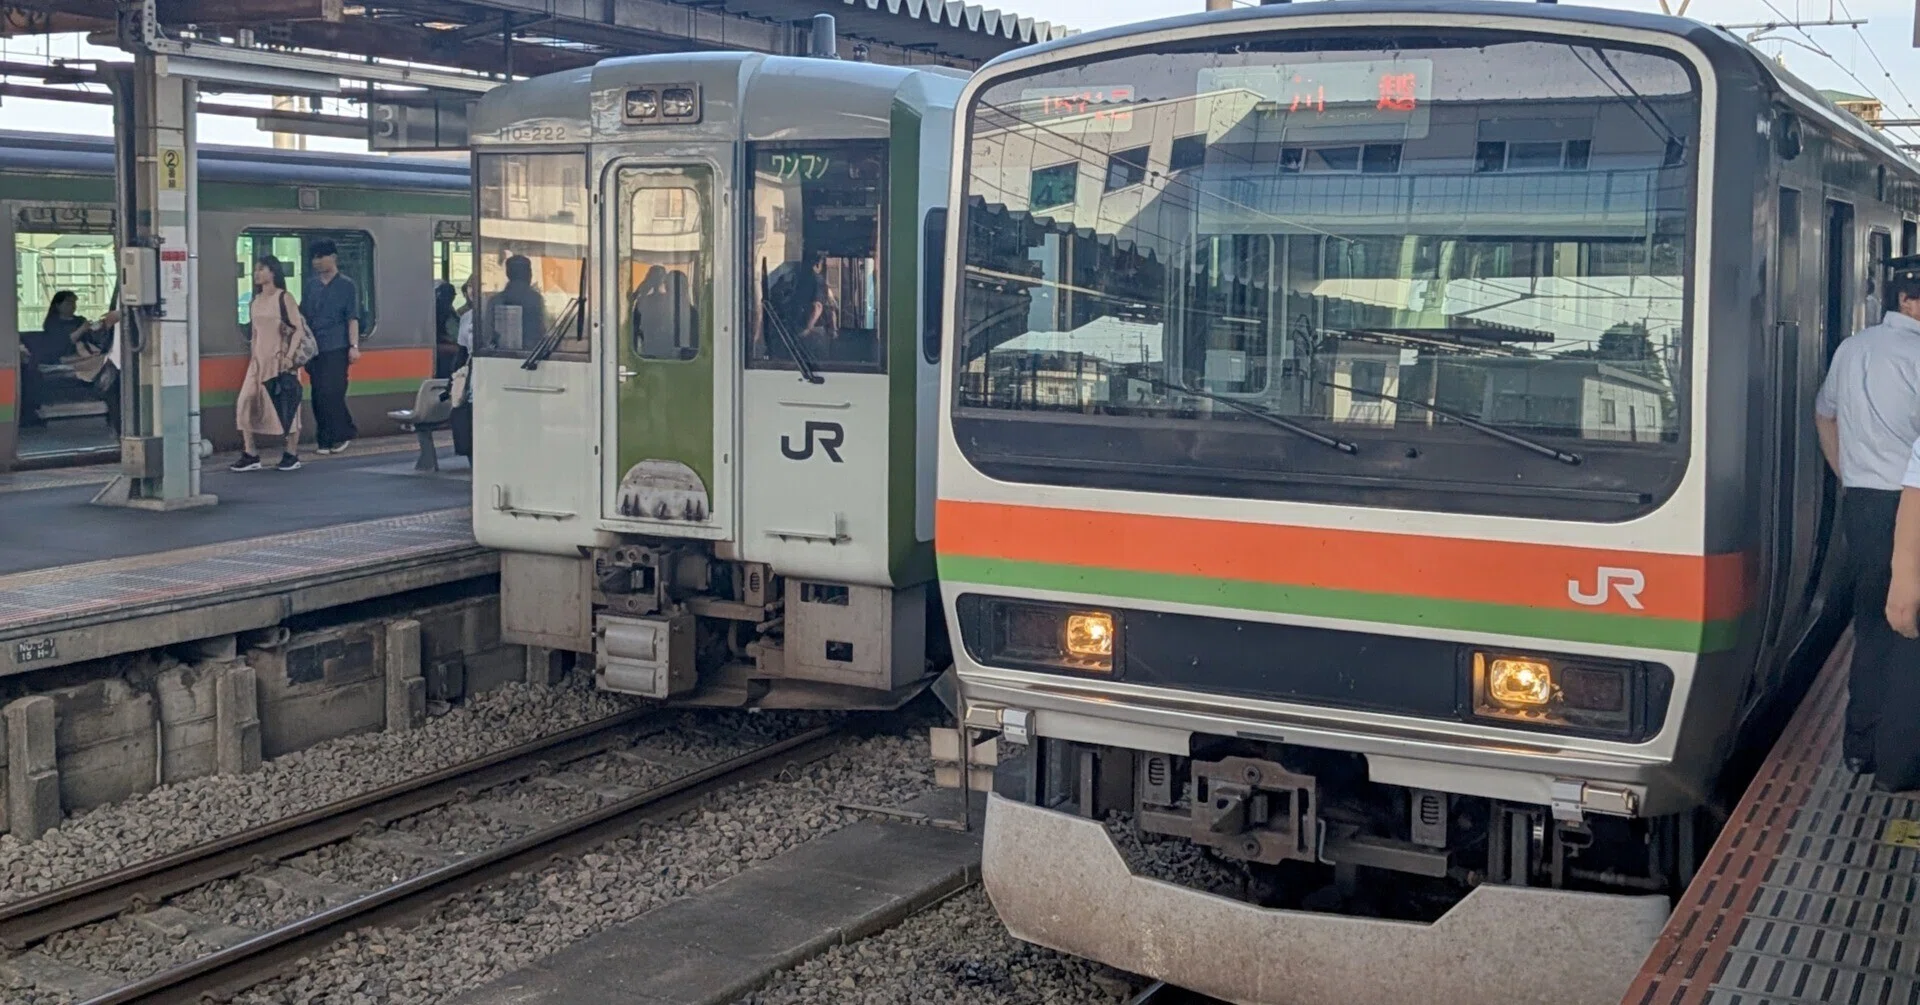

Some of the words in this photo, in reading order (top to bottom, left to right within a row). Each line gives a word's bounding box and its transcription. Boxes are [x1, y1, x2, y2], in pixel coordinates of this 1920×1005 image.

[378, 105, 393, 137] 3
[499, 126, 565, 141] 110-222
[772, 154, 829, 179] ワンマン
[781, 421, 844, 463] JR
[1568, 566, 1645, 609] JR
